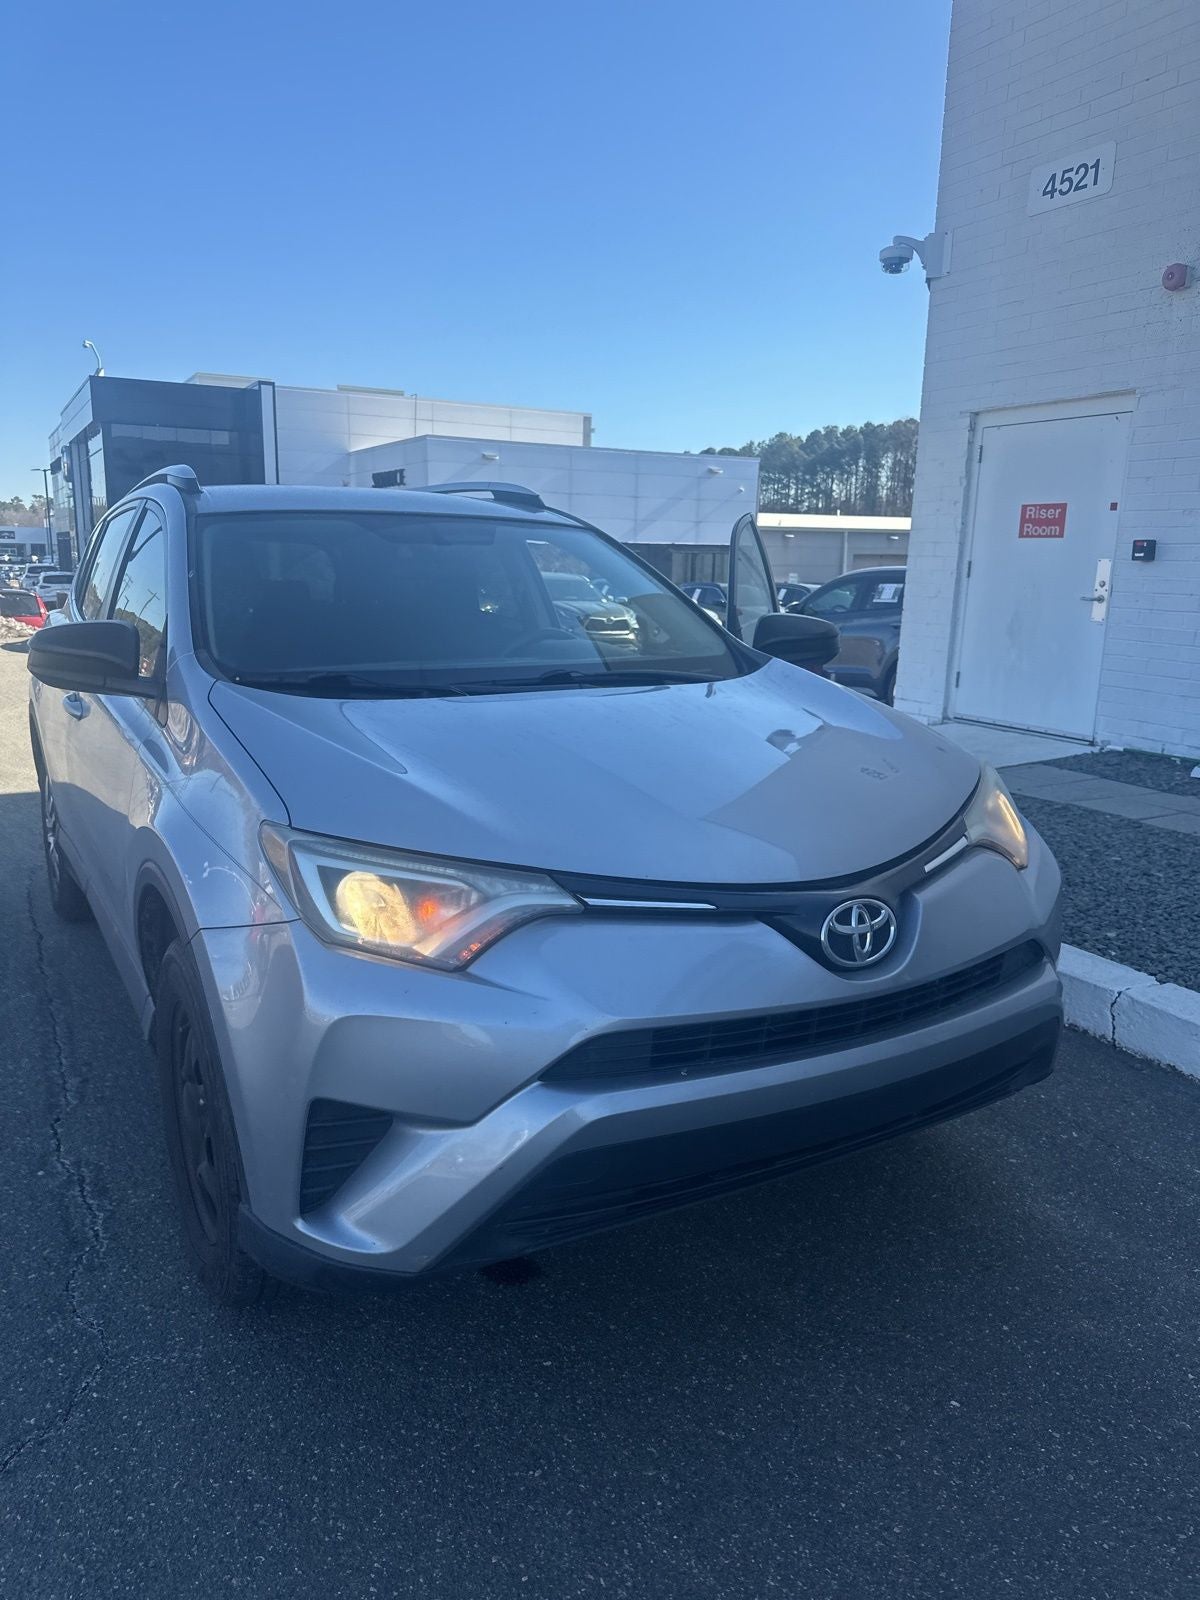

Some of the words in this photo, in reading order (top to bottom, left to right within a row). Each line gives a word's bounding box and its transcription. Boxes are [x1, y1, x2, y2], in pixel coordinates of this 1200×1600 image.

[1042, 158, 1100, 200] 4521
[1025, 505, 1062, 519] Riser
[1023, 523, 1060, 536] Room
